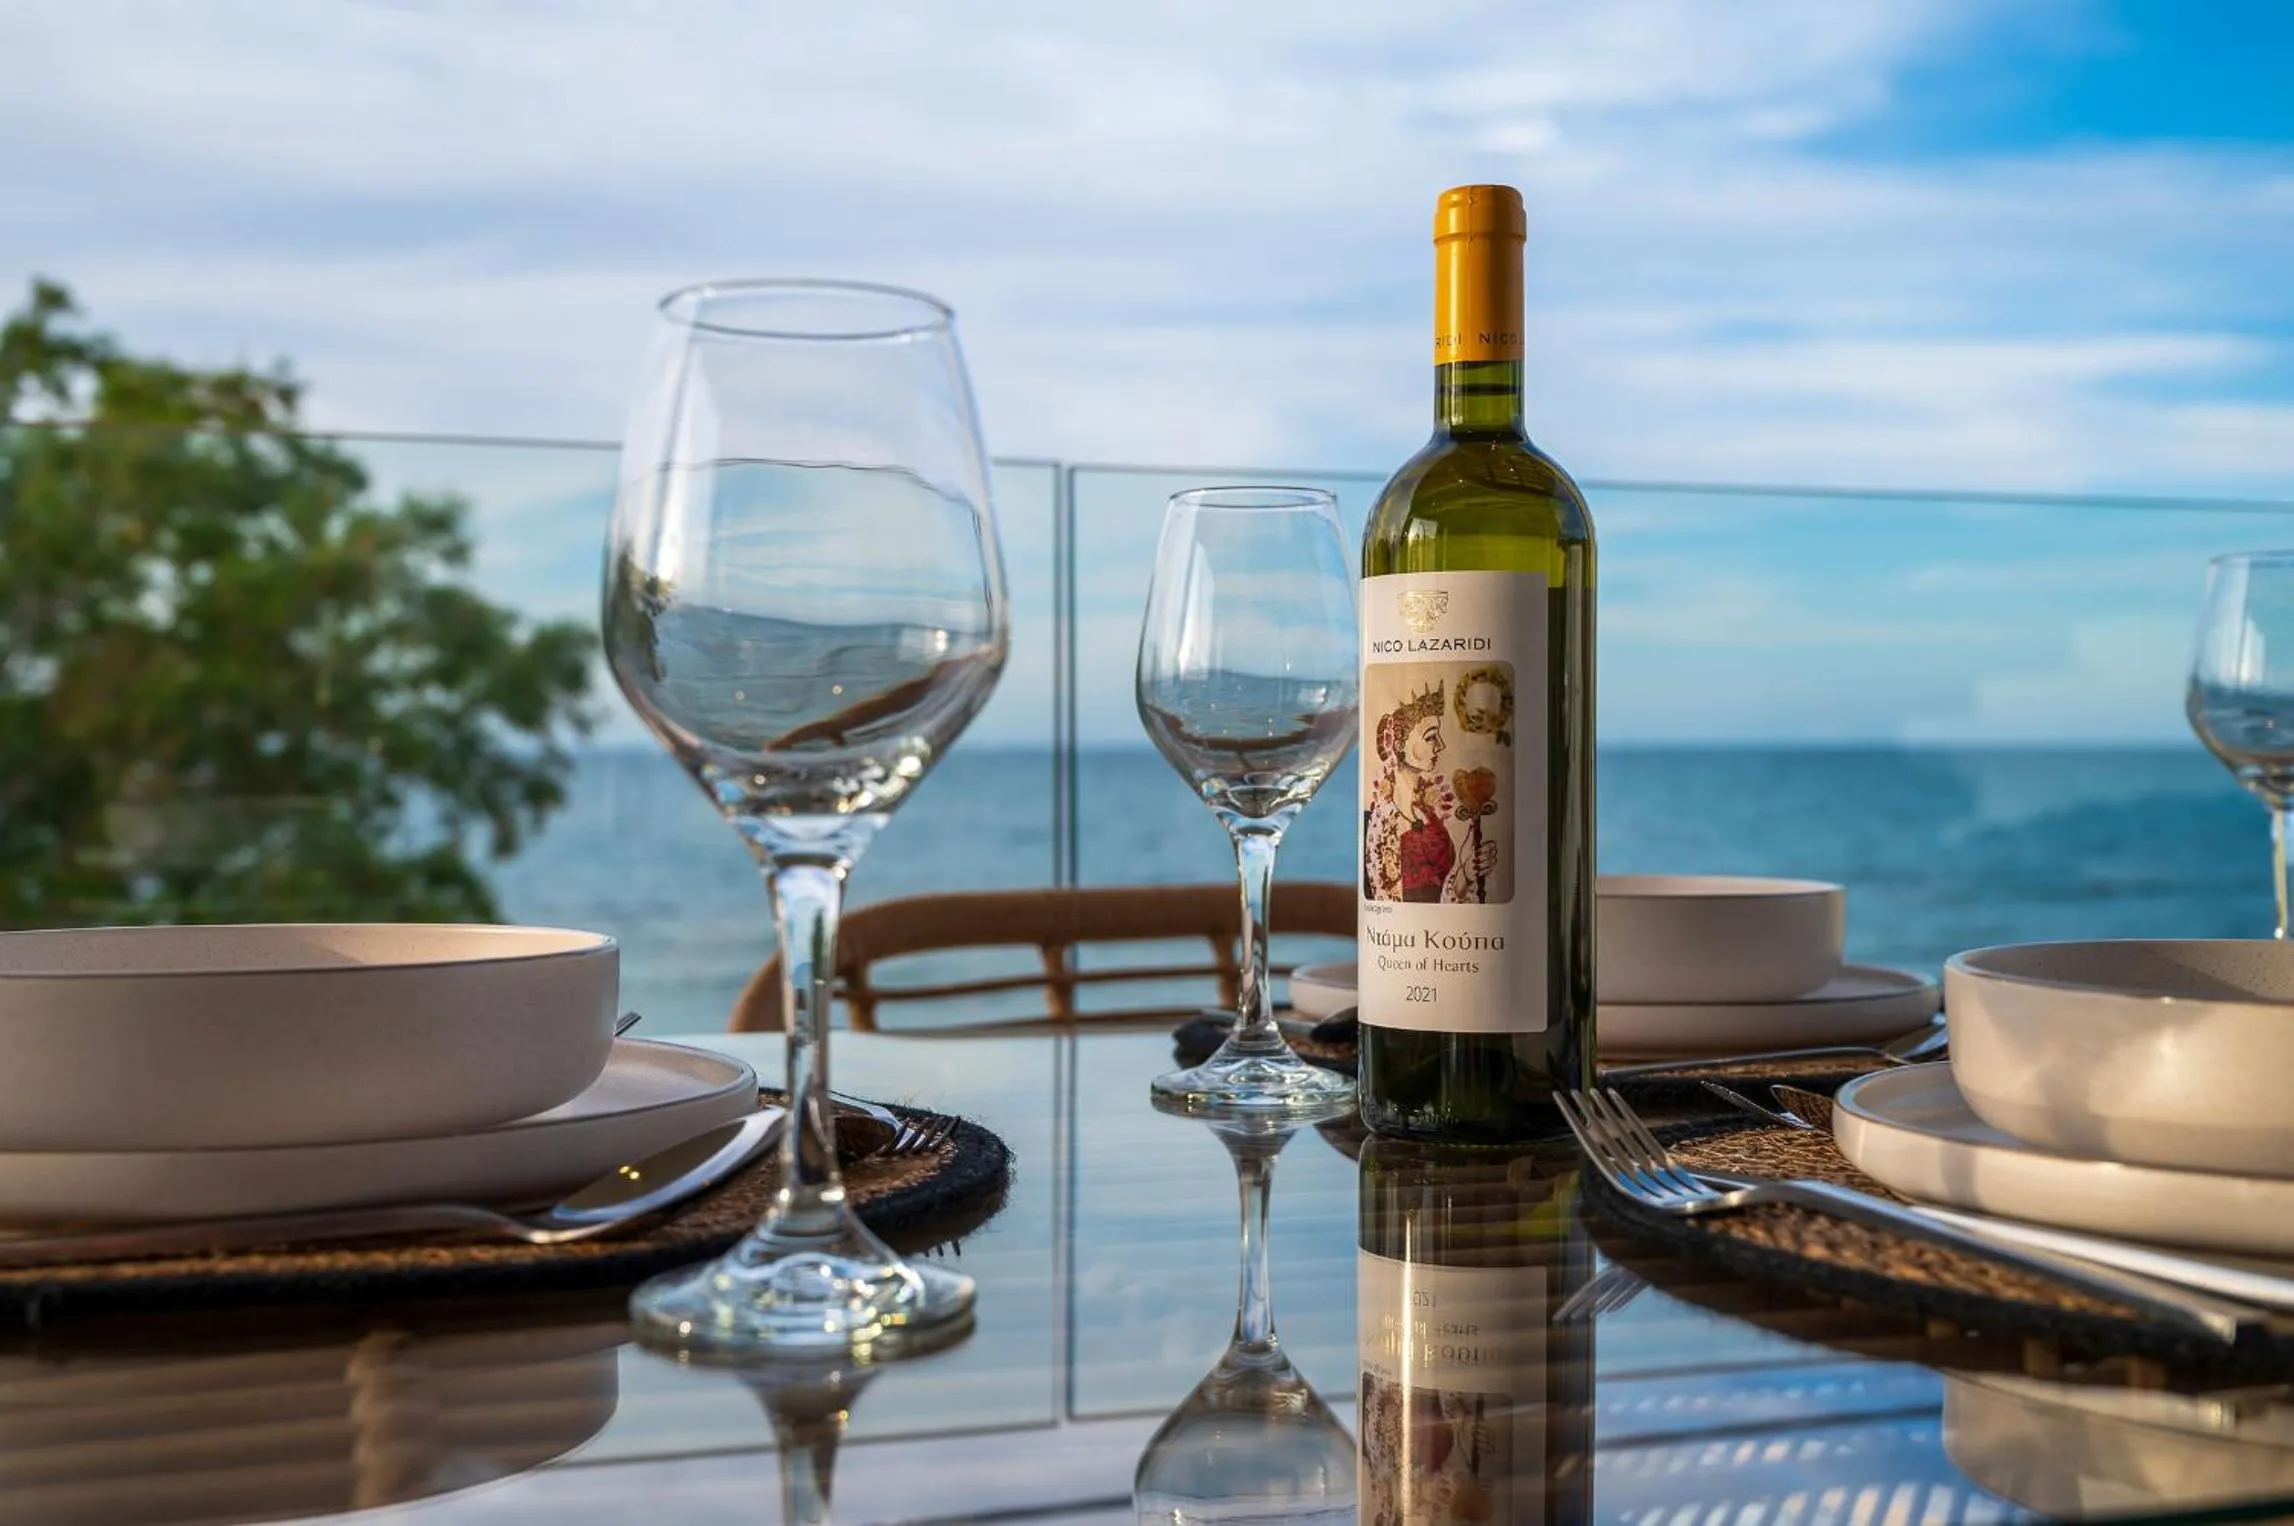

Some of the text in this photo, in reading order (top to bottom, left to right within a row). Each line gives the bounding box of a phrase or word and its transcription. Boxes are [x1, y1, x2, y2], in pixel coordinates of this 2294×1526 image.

[1479, 332, 1518, 345] NICO
[1372, 637, 1492, 653] NICO LAZARIDI
[1423, 928, 1505, 951] Κούπα
[1377, 955, 1480, 974] Queen of Hearts
[1405, 985, 1438, 1003] 2021
